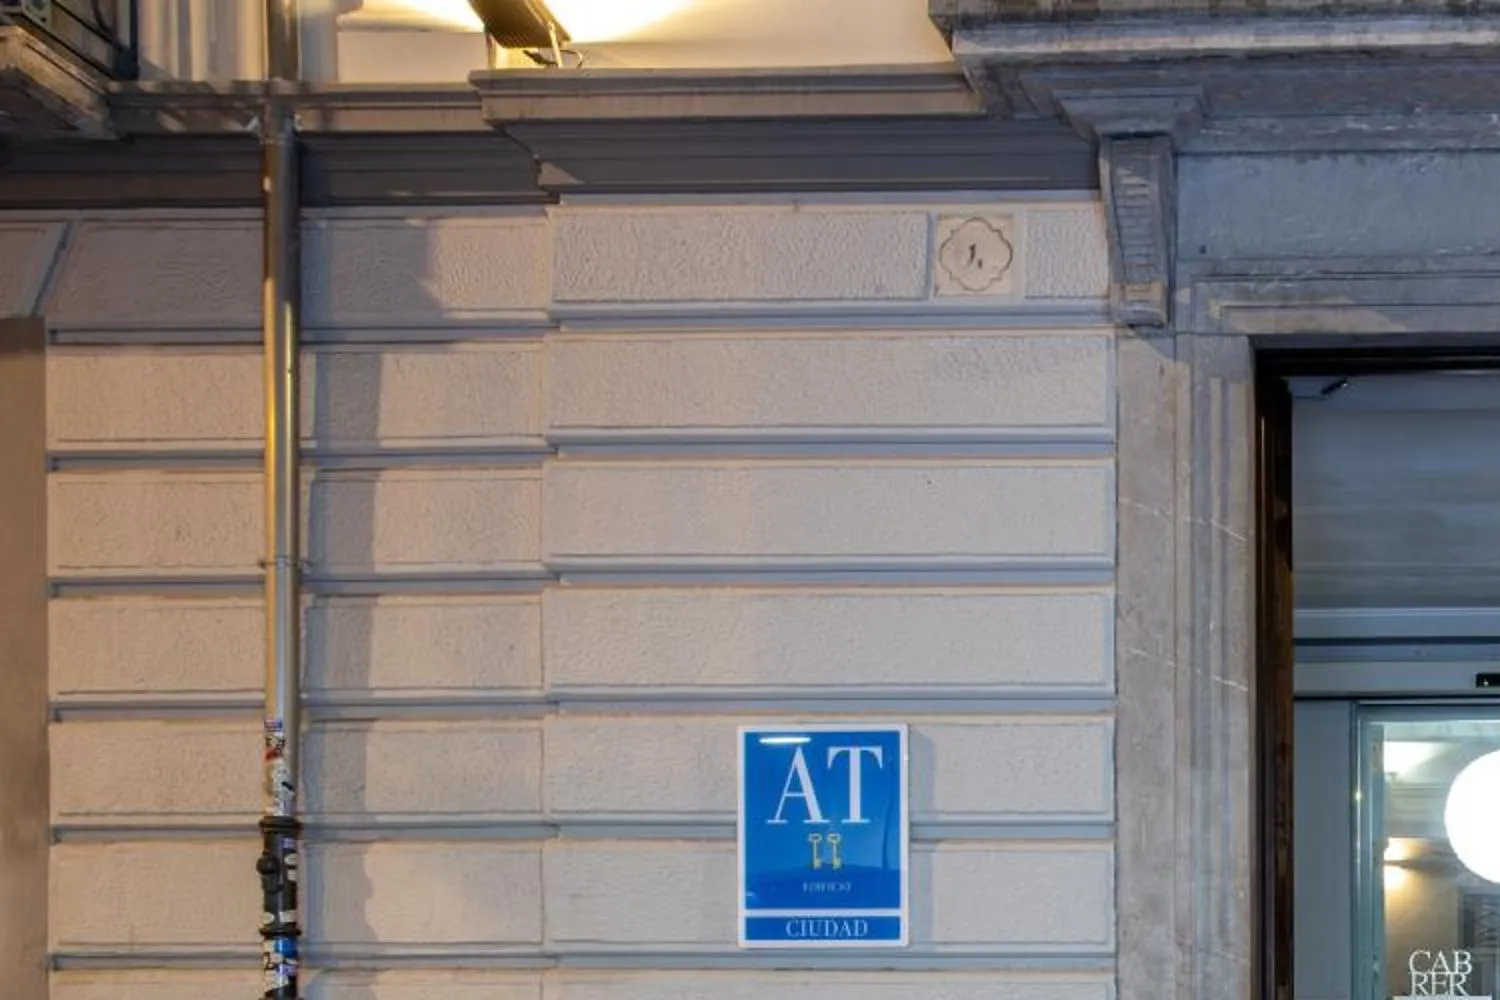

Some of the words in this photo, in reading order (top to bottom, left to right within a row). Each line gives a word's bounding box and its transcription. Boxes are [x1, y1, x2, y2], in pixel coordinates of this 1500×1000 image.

[766, 745, 883, 824] AT
[785, 918, 869, 937] CIUDAD
[1409, 950, 1473, 975] CAB
